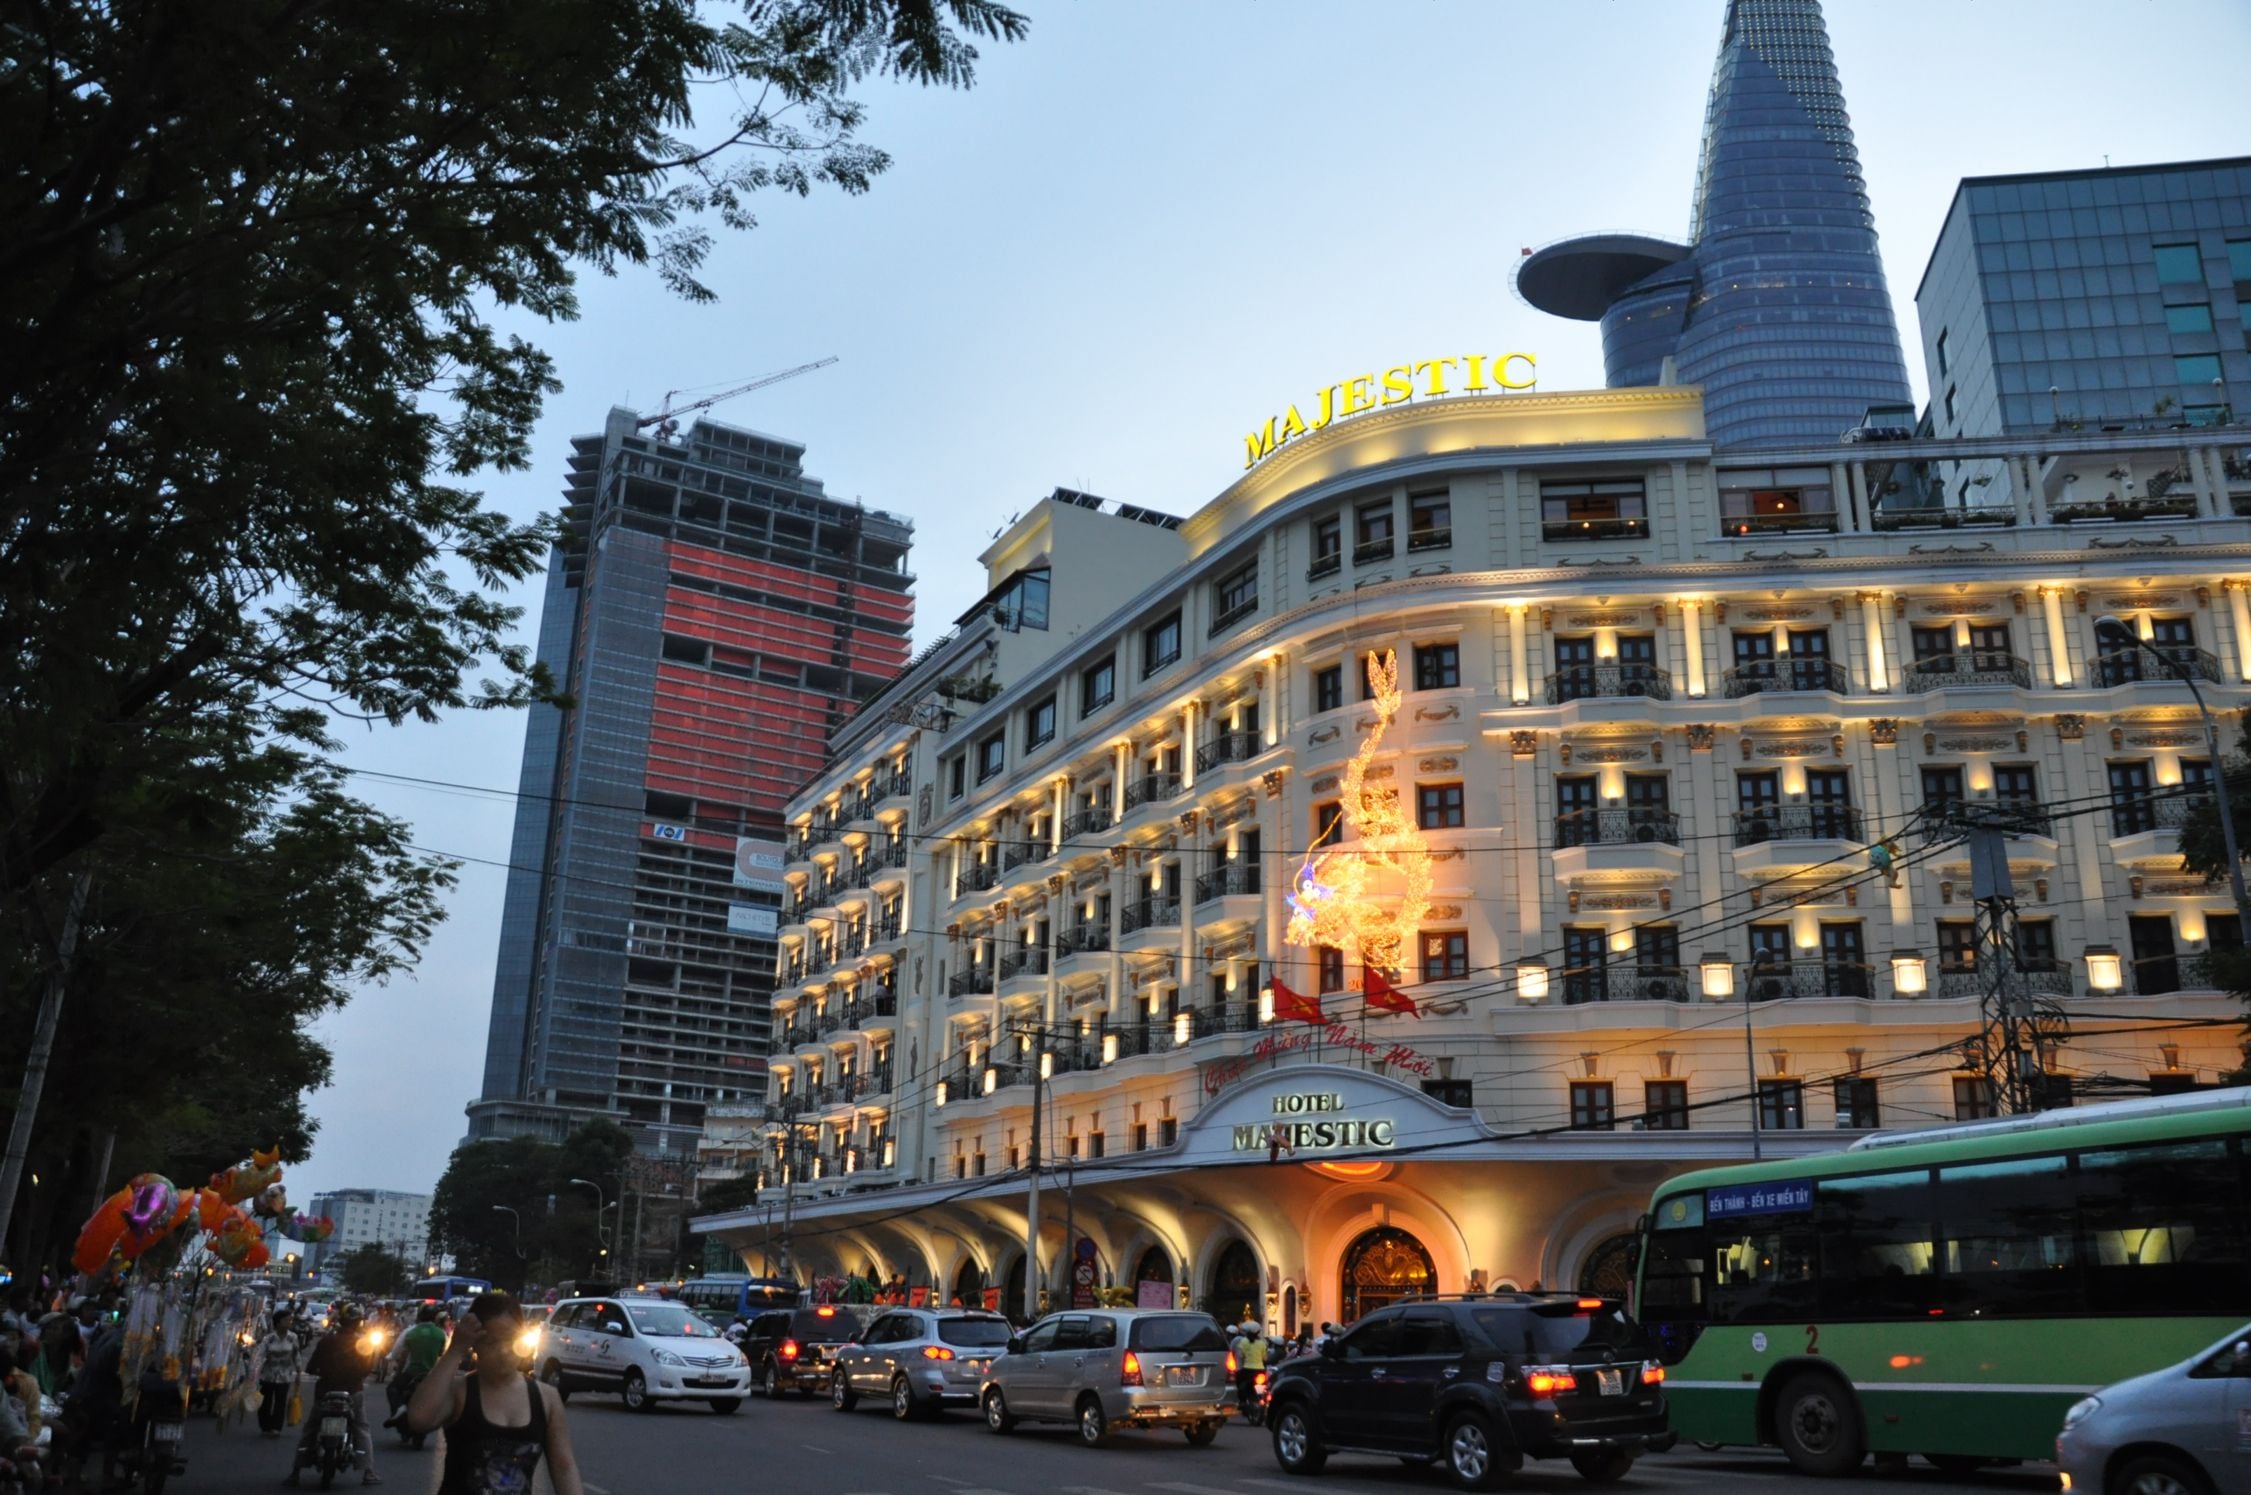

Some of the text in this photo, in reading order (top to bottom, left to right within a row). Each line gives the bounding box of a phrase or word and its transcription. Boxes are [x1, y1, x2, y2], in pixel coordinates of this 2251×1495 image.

[1244, 351, 1537, 470] MAJESTIC
[1272, 1093, 1345, 1114] HOTEL
[1766, 1193, 1776, 1207] XE
[1806, 1324, 1819, 1354] 2
